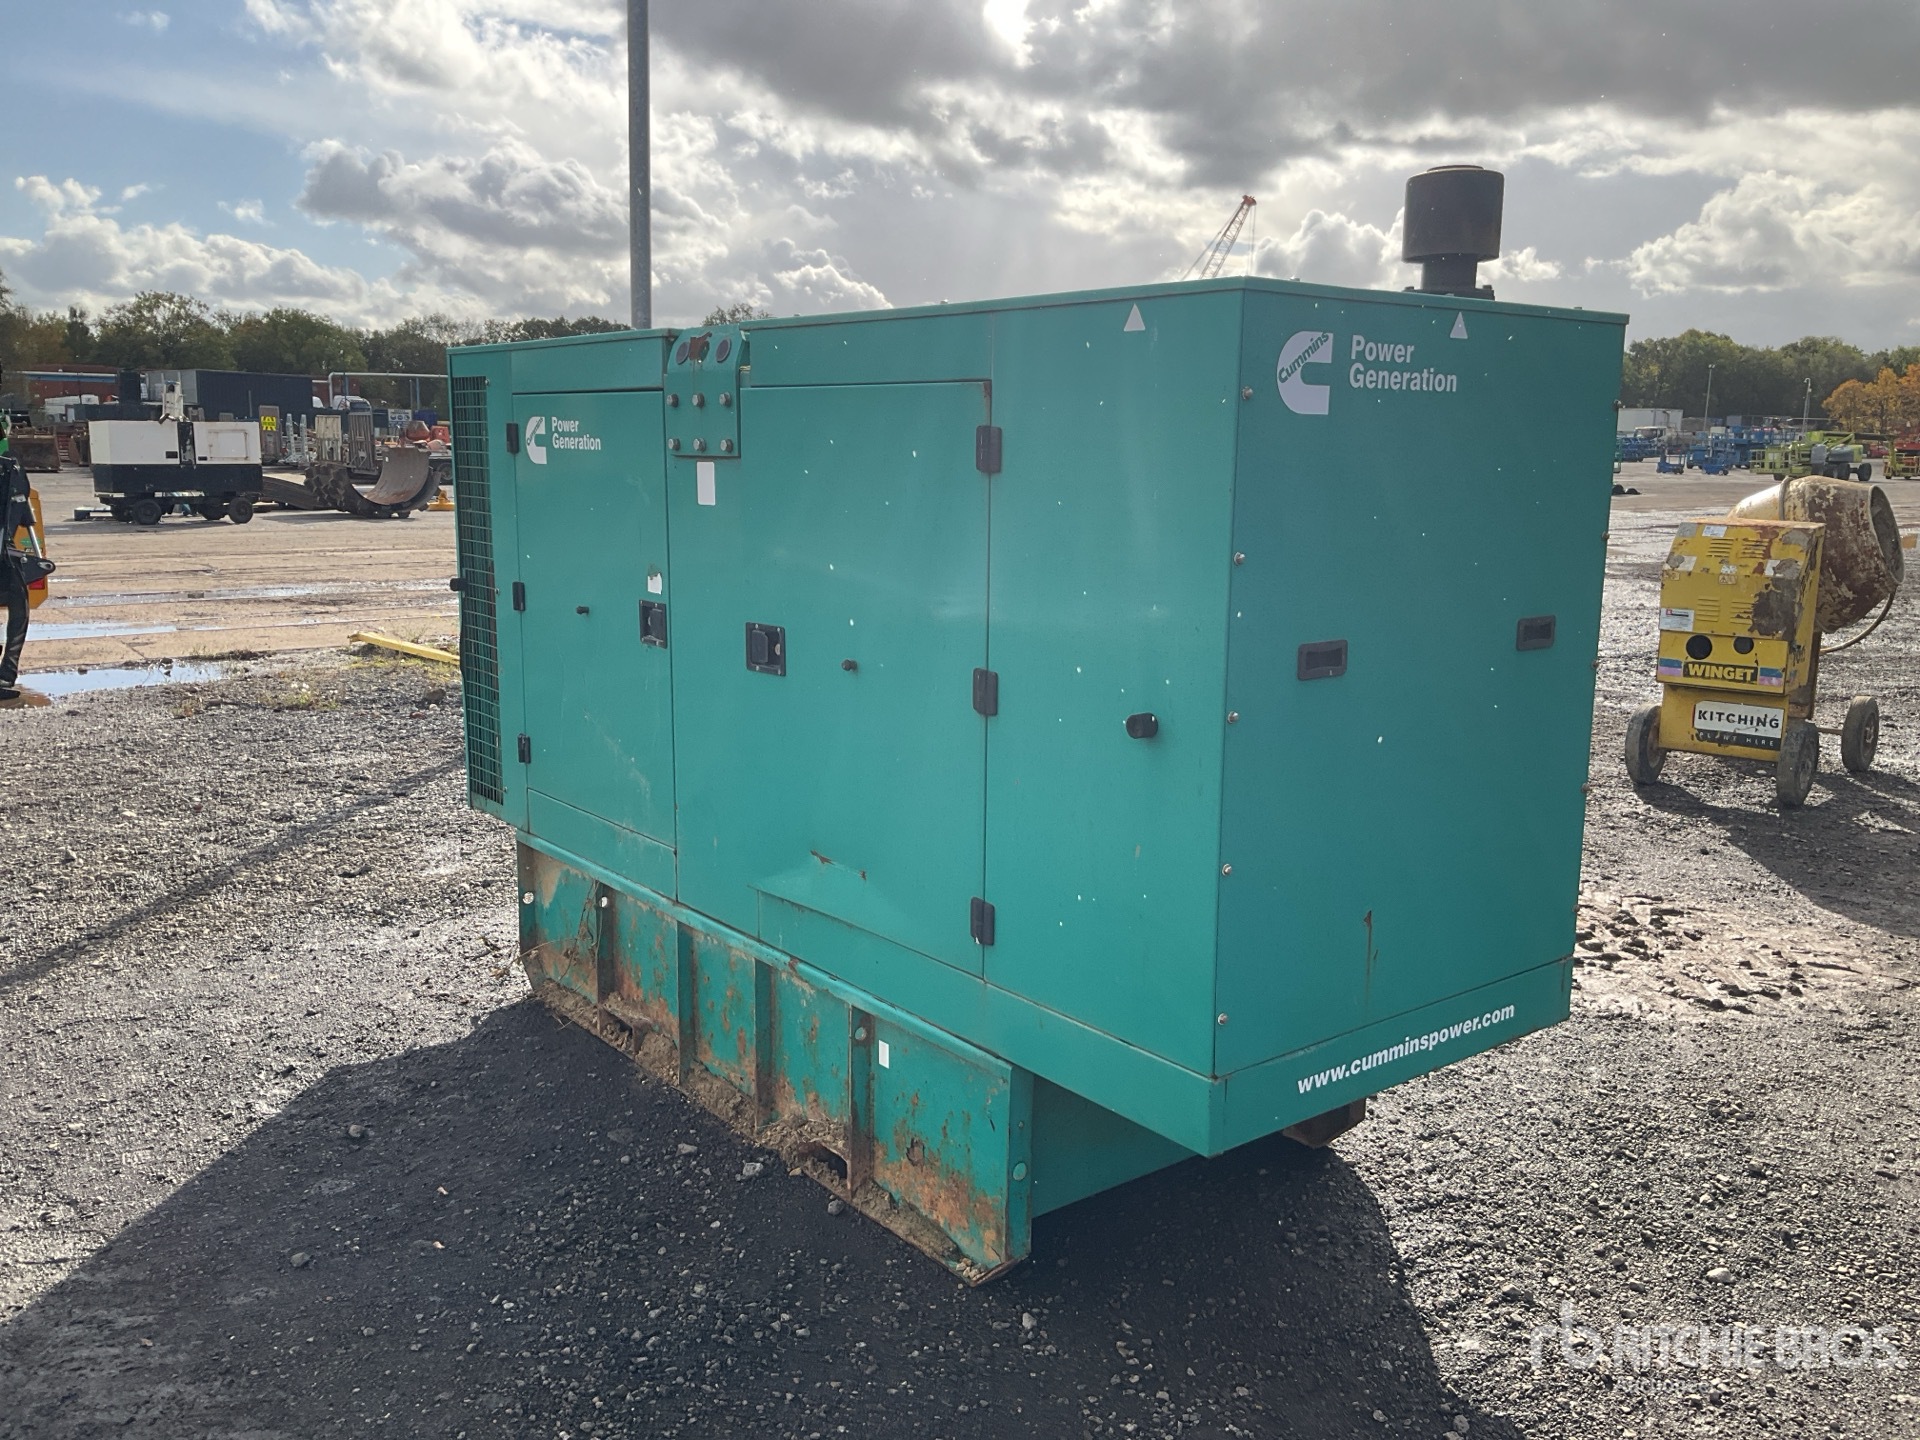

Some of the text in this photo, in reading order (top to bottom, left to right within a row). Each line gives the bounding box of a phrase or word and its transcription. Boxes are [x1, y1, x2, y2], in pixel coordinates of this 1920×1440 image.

[1278, 332, 1329, 384] Cummins
[1351, 334, 1414, 363] Power
[1350, 362, 1457, 393] Generation
[551, 416, 579, 433] Power
[552, 432, 602, 451] Generation
[1688, 663, 1755, 683] WINGET
[1698, 709, 1780, 730] KITCHING
[1297, 1004, 1515, 1094] www.cumminspower.com
